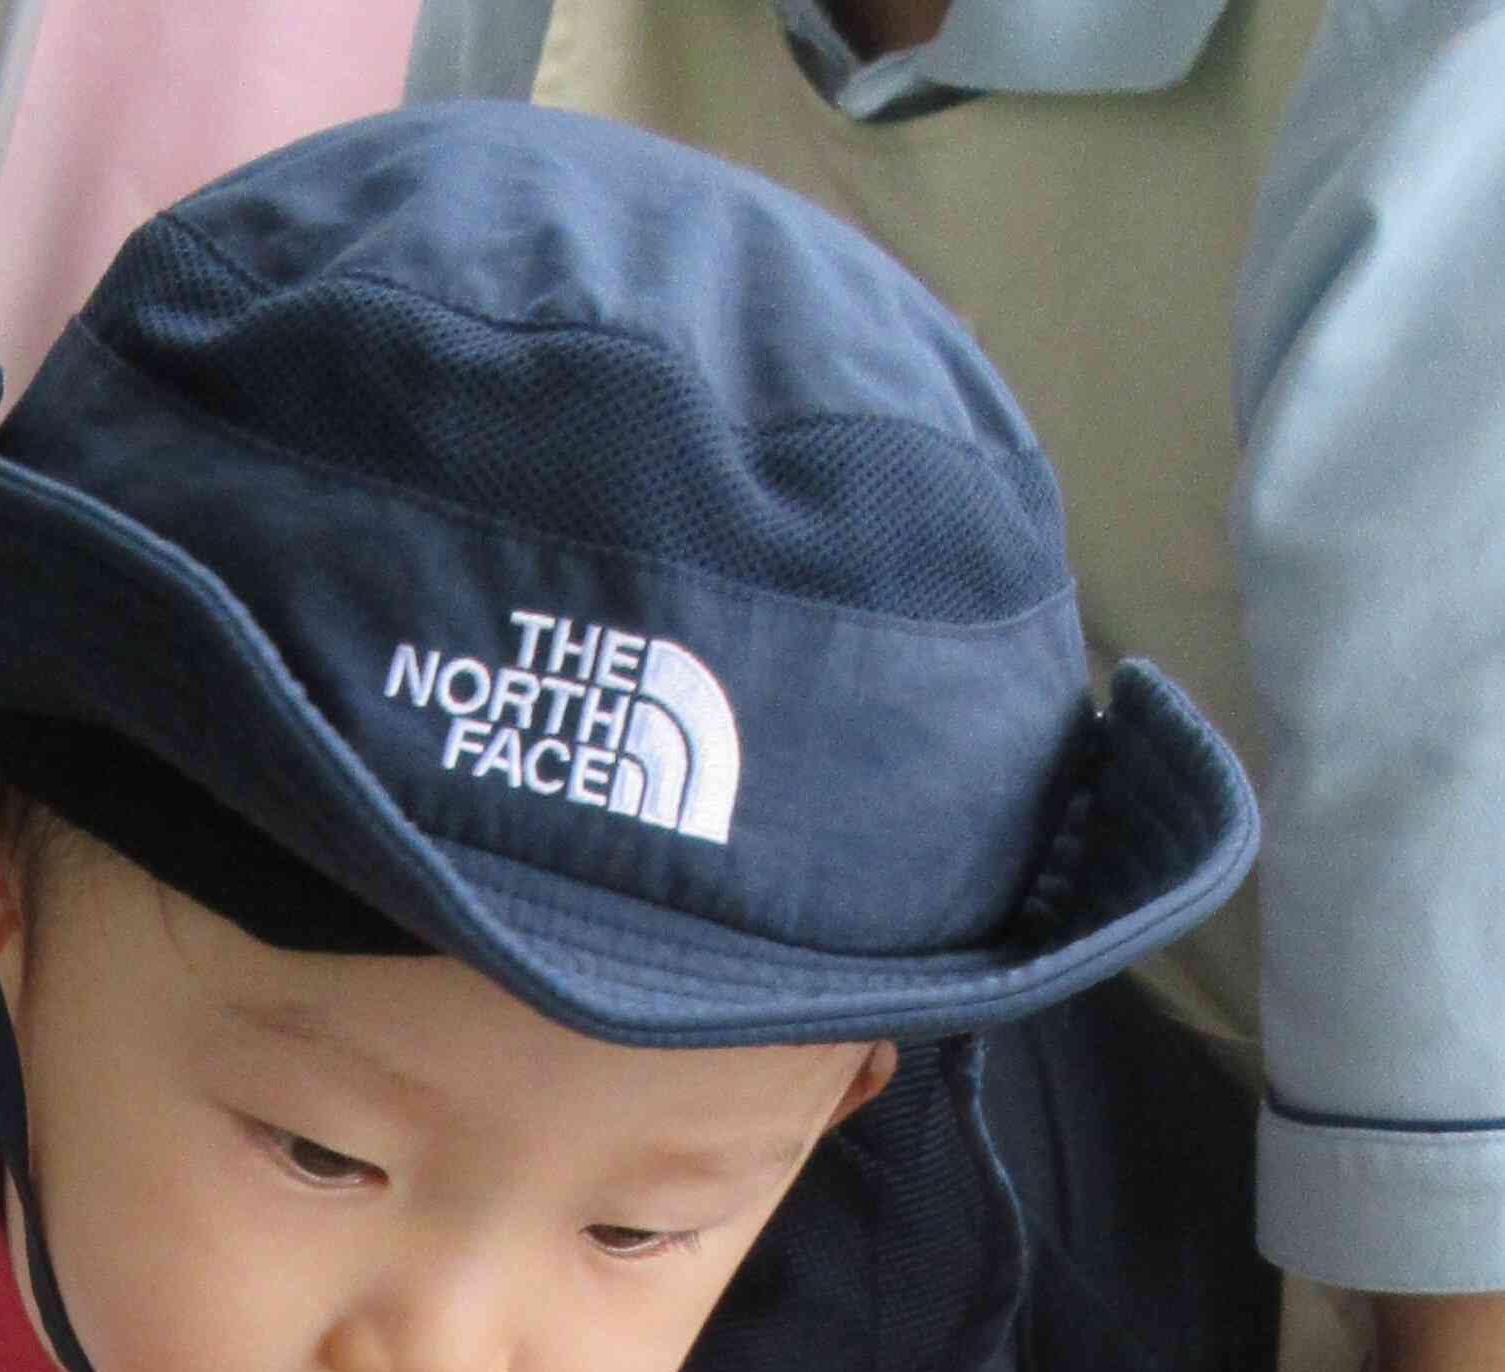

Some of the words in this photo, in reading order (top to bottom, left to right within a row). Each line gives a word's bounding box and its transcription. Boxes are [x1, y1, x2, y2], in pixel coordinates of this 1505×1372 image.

[383, 642, 632, 752] NORTH
[509, 609, 647, 693] THE
[441, 716, 617, 808] FACE
